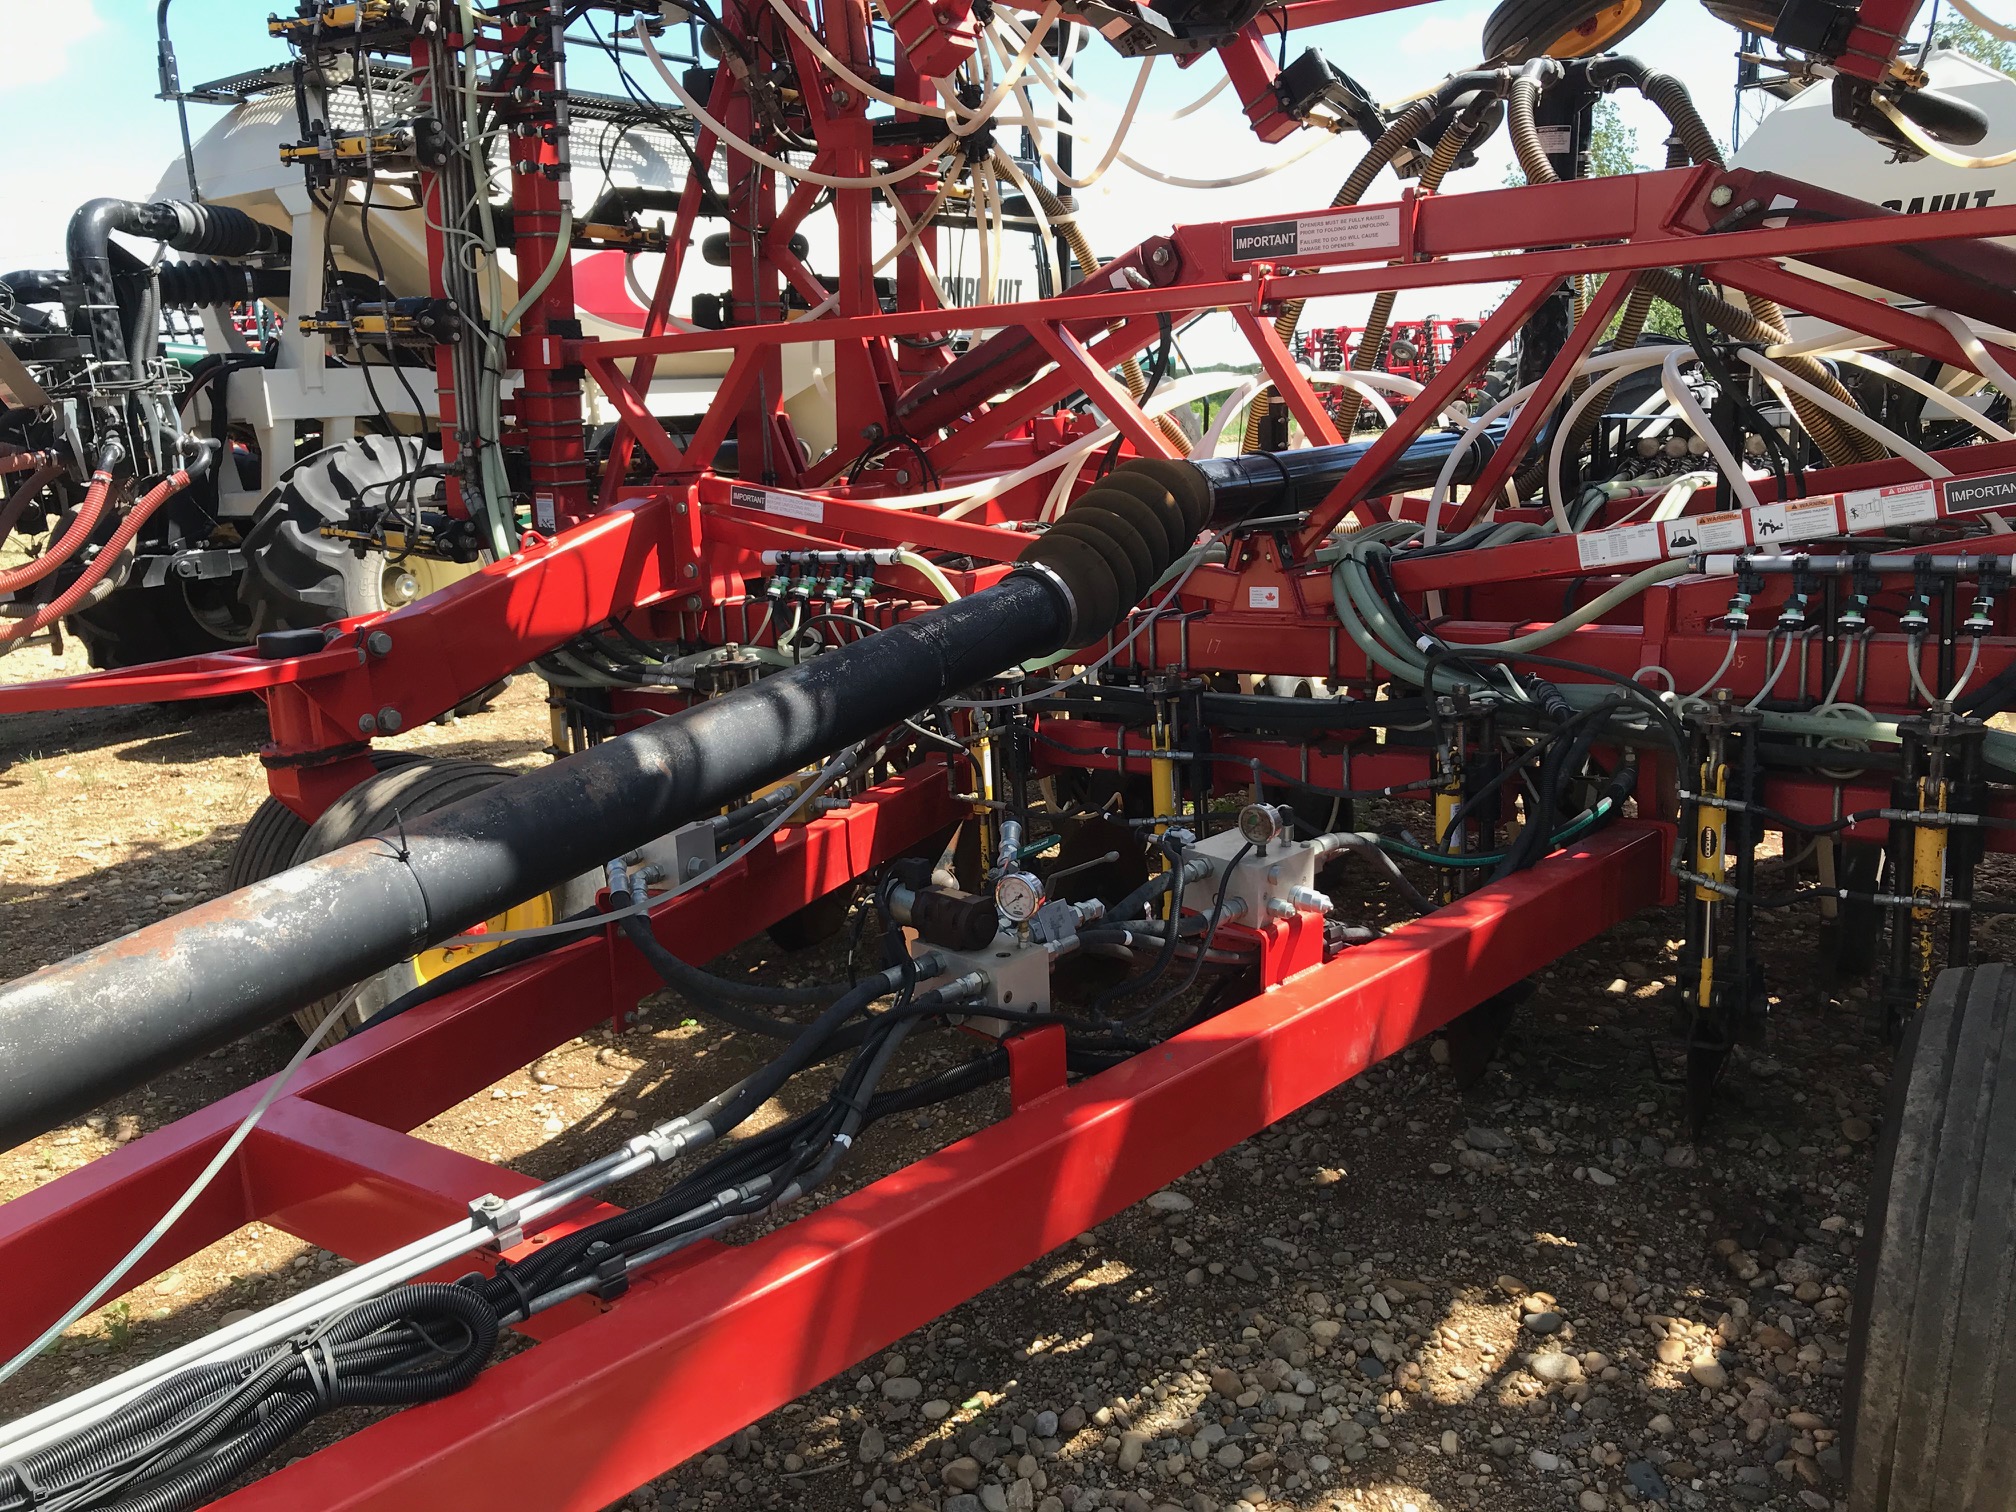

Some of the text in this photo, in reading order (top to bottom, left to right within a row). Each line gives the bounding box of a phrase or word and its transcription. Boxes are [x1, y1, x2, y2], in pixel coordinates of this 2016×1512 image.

[1236, 232, 1296, 249] IMPORTANT
[1897, 484, 1924, 493] DANGER
[733, 492, 765, 504] IMPORTANT
[1800, 500, 1828, 508] WARNING
[1706, 514, 1737, 522] WARNING
